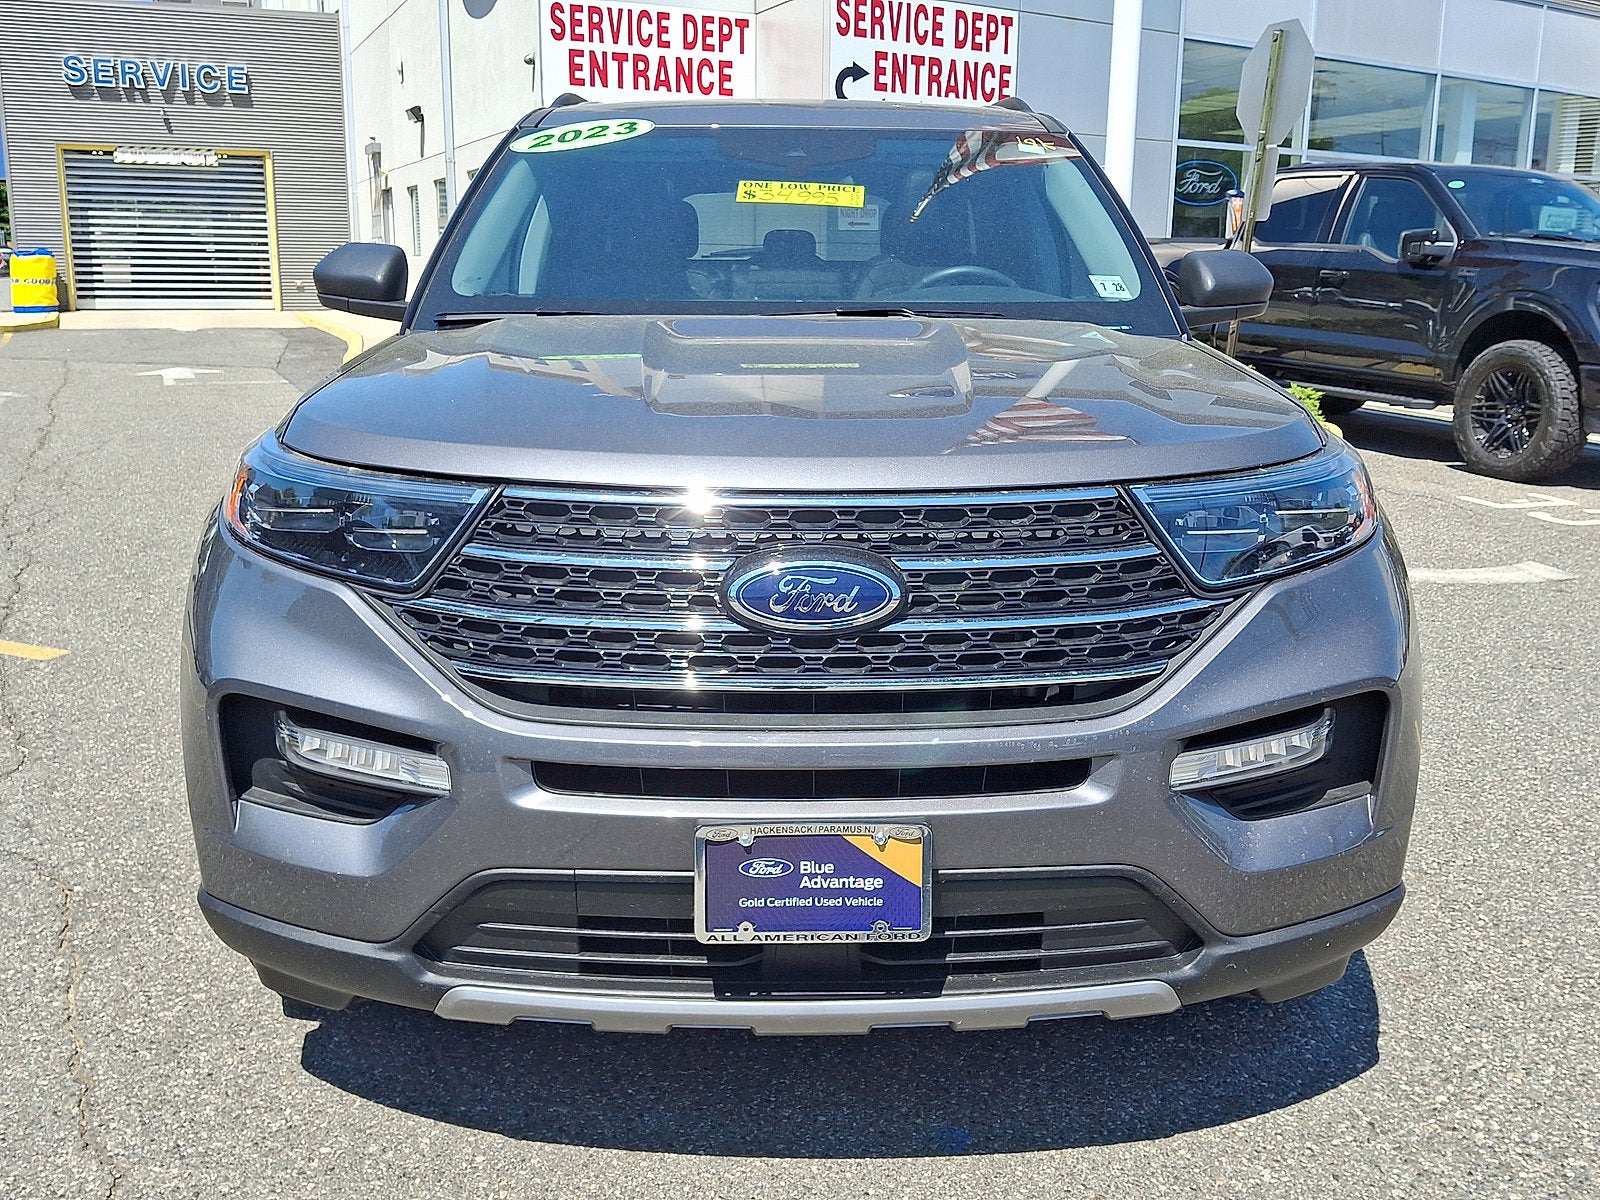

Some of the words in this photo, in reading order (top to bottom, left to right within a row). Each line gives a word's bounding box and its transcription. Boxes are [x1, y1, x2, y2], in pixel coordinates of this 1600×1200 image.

[550, 2, 671, 48] SERVICE
[682, 14, 750, 54] DEPT
[836, 0, 945, 47] SERVICE
[954, 9, 1014, 55] DEPT
[62, 54, 249, 95] SERVICE
[568, 49, 734, 97] ENTRANCE
[873, 51, 1012, 103] ENTRANCE
[527, 121, 638, 150] 2023
[743, 181, 773, 189] ONE
[780, 182, 811, 191] LOW
[818, 184, 860, 194] PRICE
[1176, 168, 1224, 195] Ford
[1100, 282, 1107, 291] 7
[769, 575, 861, 614] Ford
[864, 825, 876, 834] NJ
[748, 860, 784, 875] Ford
[799, 860, 835, 875] Blue
[799, 875, 884, 892] Advantage
[738, 897, 765, 908] Gold
[766, 896, 813, 908] Certified
[814, 896, 842, 907] Used
[844, 896, 884, 907] Vehicle
[706, 934, 745, 943] ALL
[750, 933, 859, 942] AMERICAN
[865, 932, 922, 942] FORD
